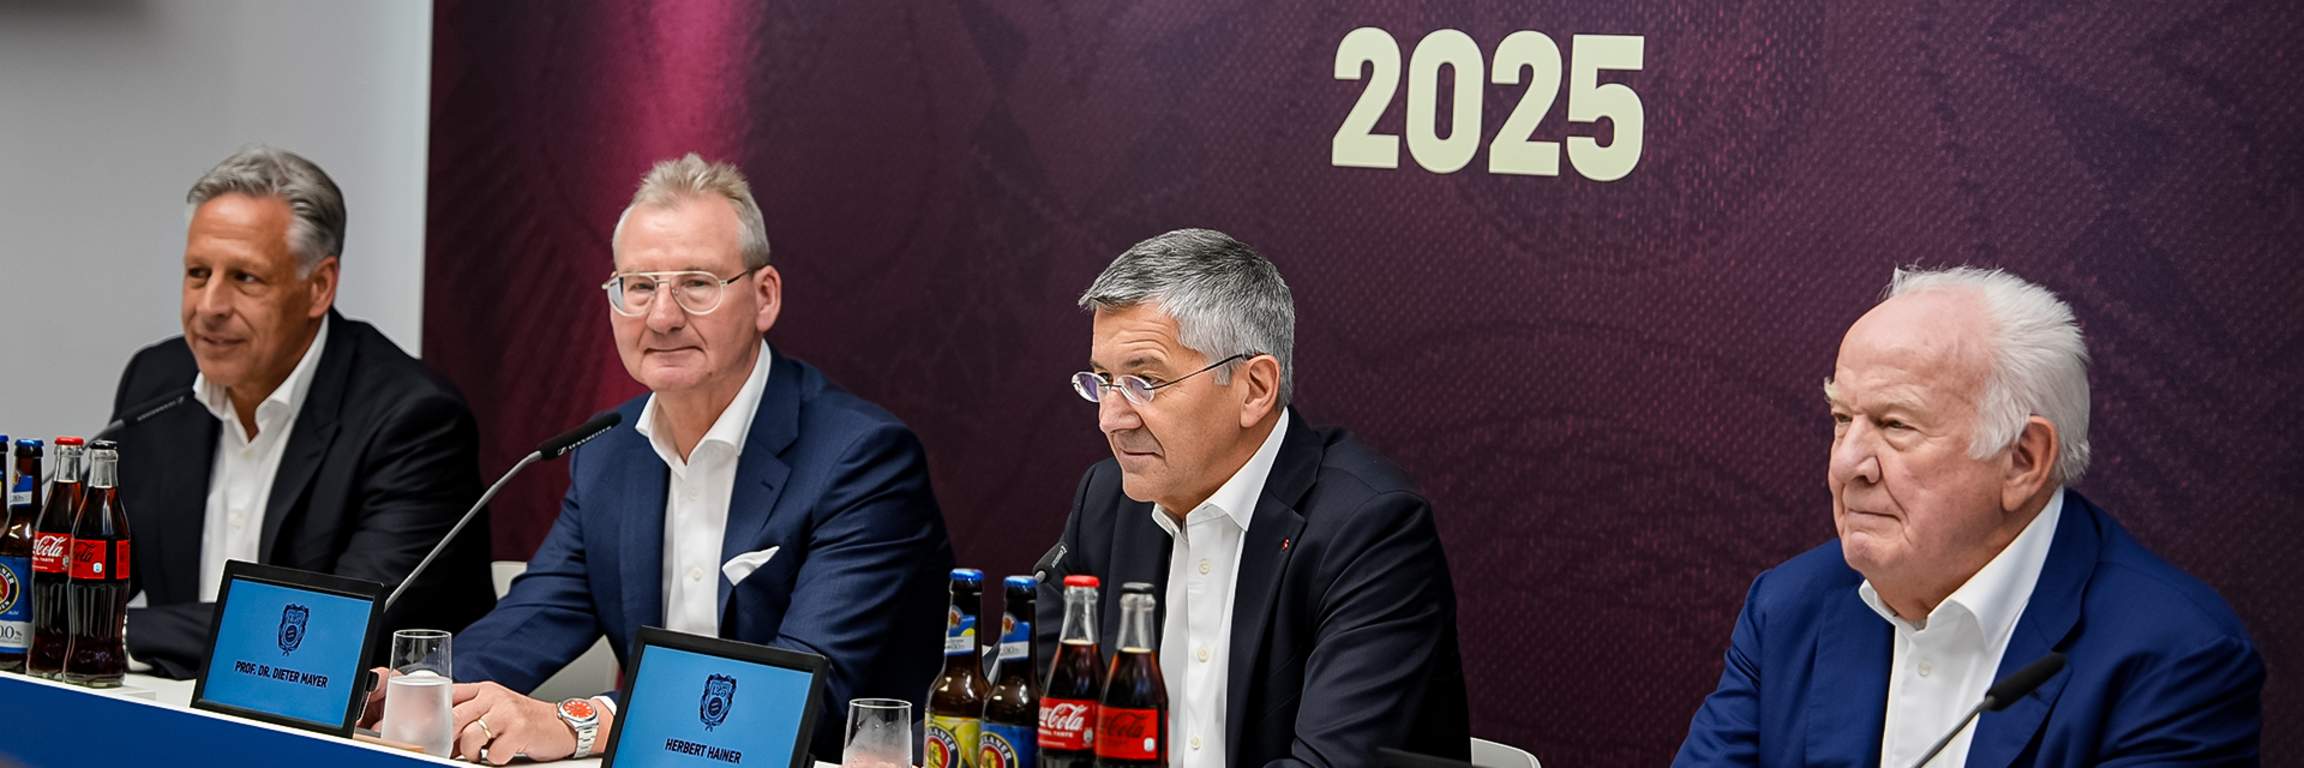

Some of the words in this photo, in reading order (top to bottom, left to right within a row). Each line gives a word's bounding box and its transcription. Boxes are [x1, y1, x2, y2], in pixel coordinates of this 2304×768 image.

[1331, 26, 1645, 182] 2025
[235, 661, 256, 675] PROF.
[258, 665, 271, 678] DR.
[273, 667, 299, 683] DIETER
[300, 673, 328, 687] MAYER
[665, 738, 706, 757] HERBERT
[707, 746, 741, 764] HAINER
